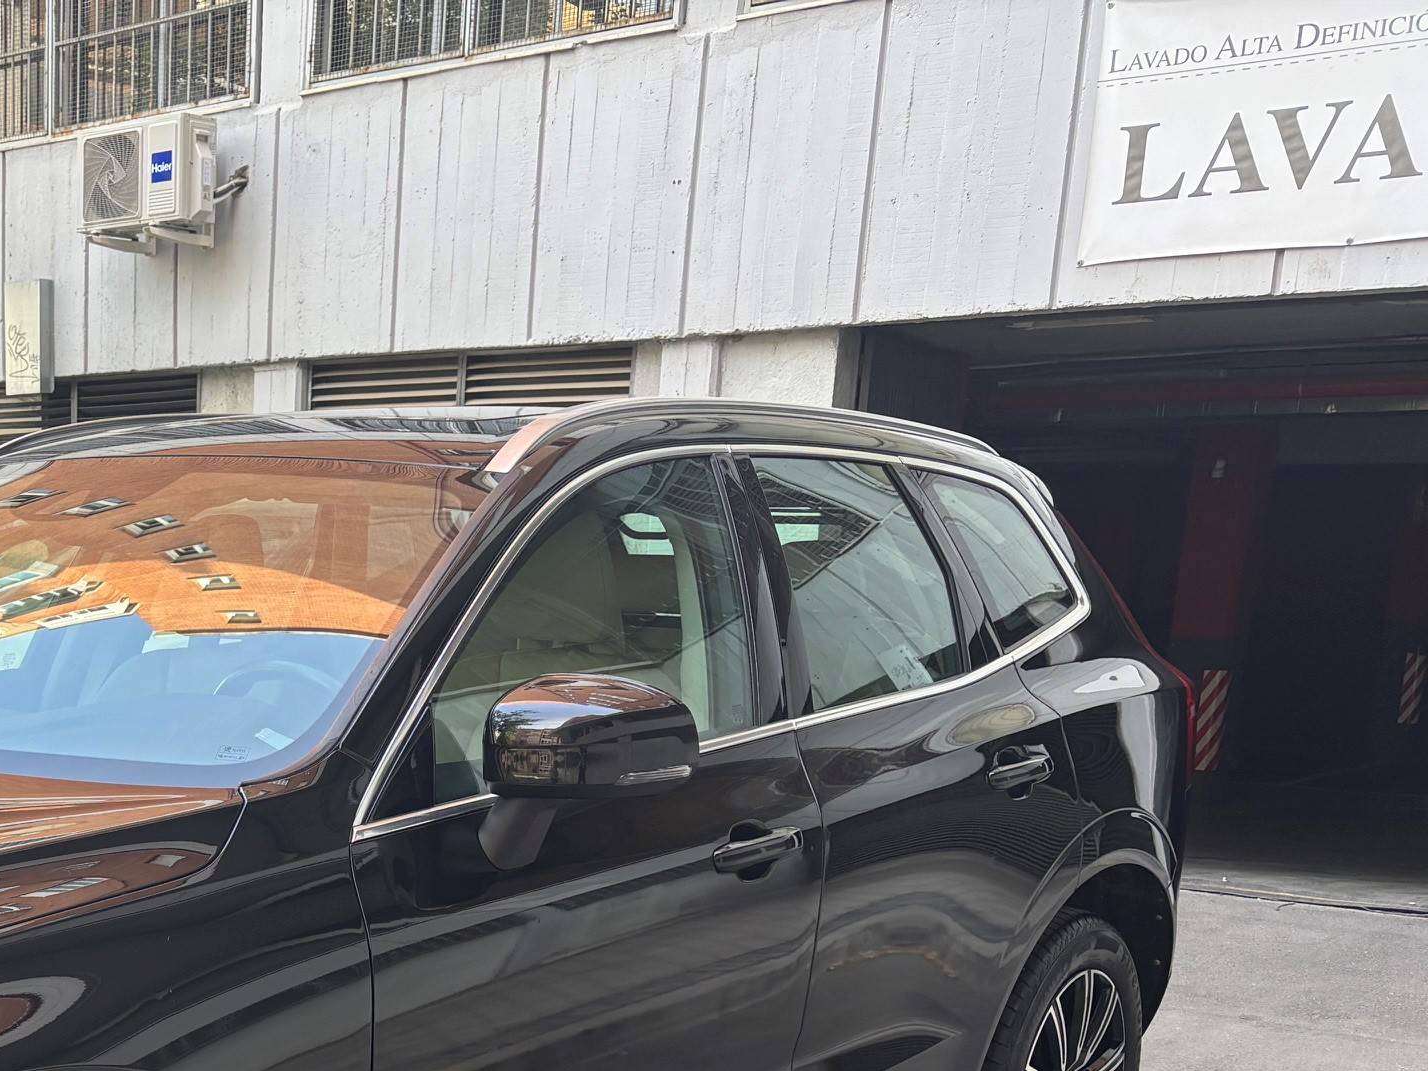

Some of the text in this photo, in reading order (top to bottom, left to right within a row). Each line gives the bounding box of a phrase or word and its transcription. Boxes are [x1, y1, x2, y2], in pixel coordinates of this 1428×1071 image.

[1108, 45, 1208, 74] LAVADO
[1214, 34, 1283, 61] ALTA
[151, 162, 172, 173] Haier
[1111, 93, 1424, 206] LAVA
